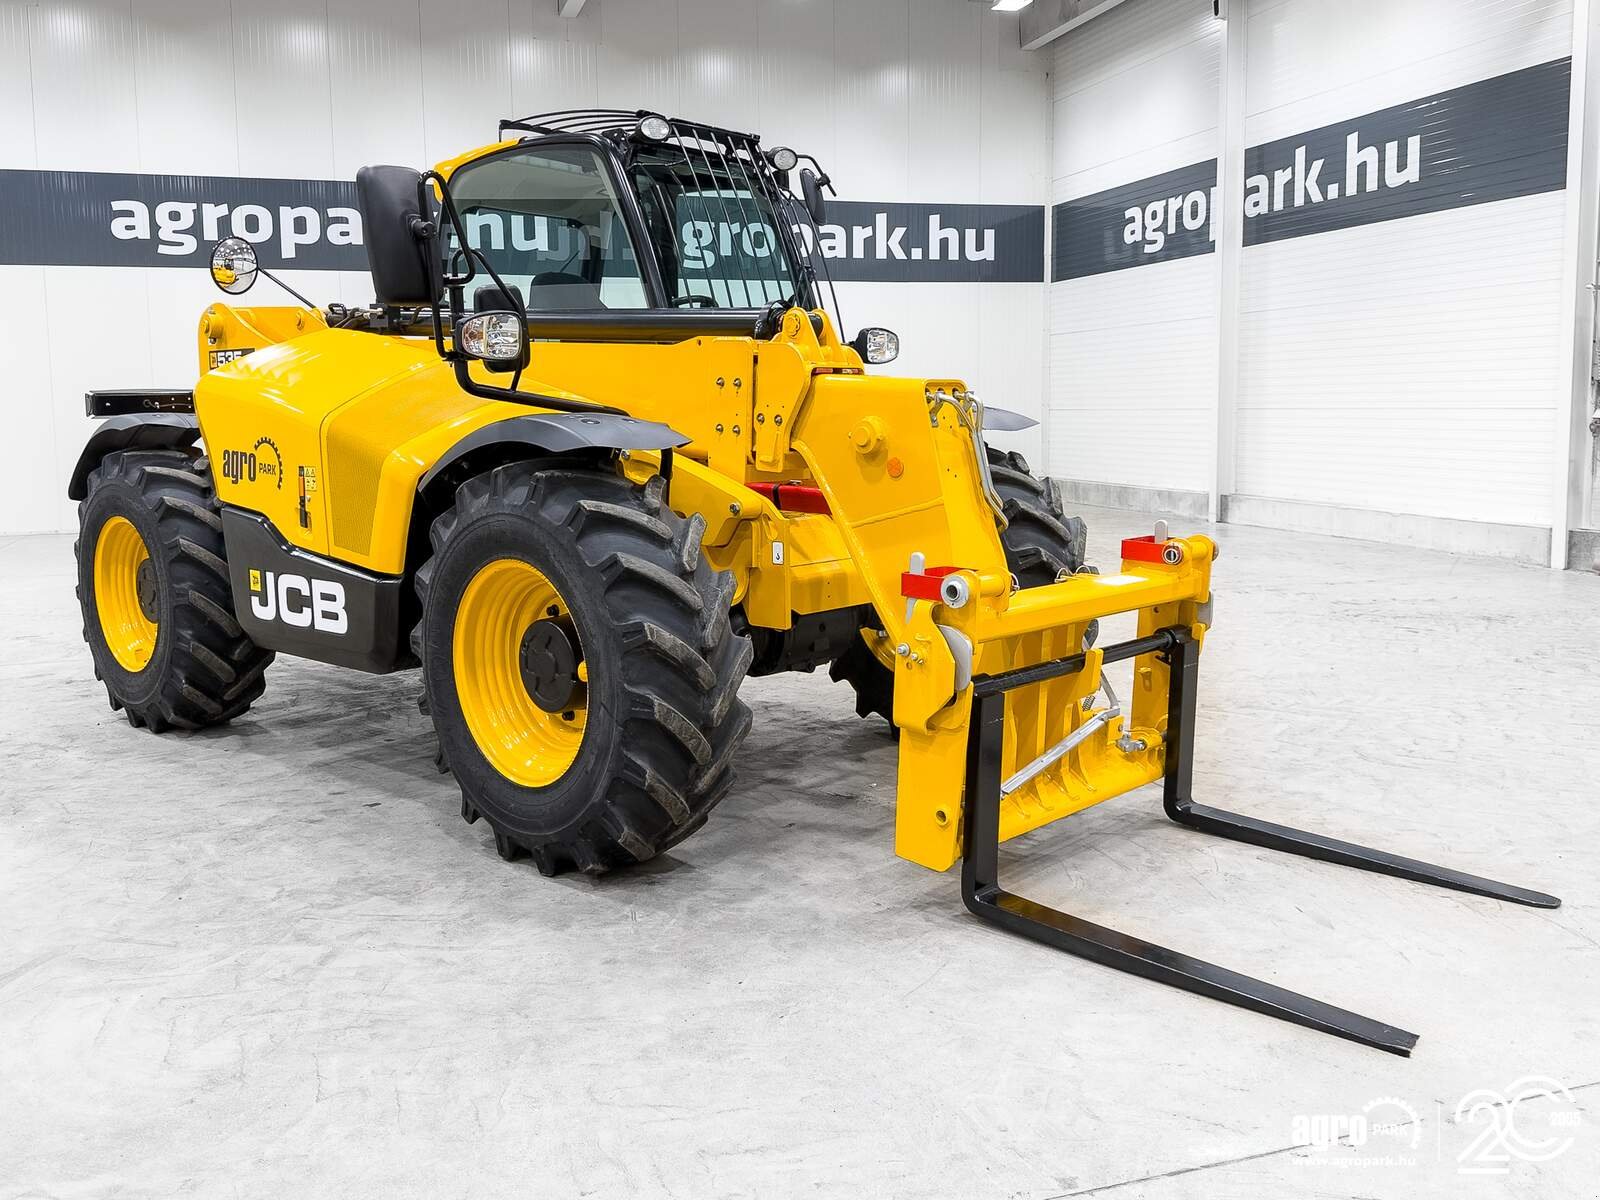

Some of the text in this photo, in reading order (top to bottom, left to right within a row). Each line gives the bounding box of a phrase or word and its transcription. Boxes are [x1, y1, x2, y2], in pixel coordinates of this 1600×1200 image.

[223, 449, 277, 485] agro PARK
[250, 571, 348, 635] JCB
